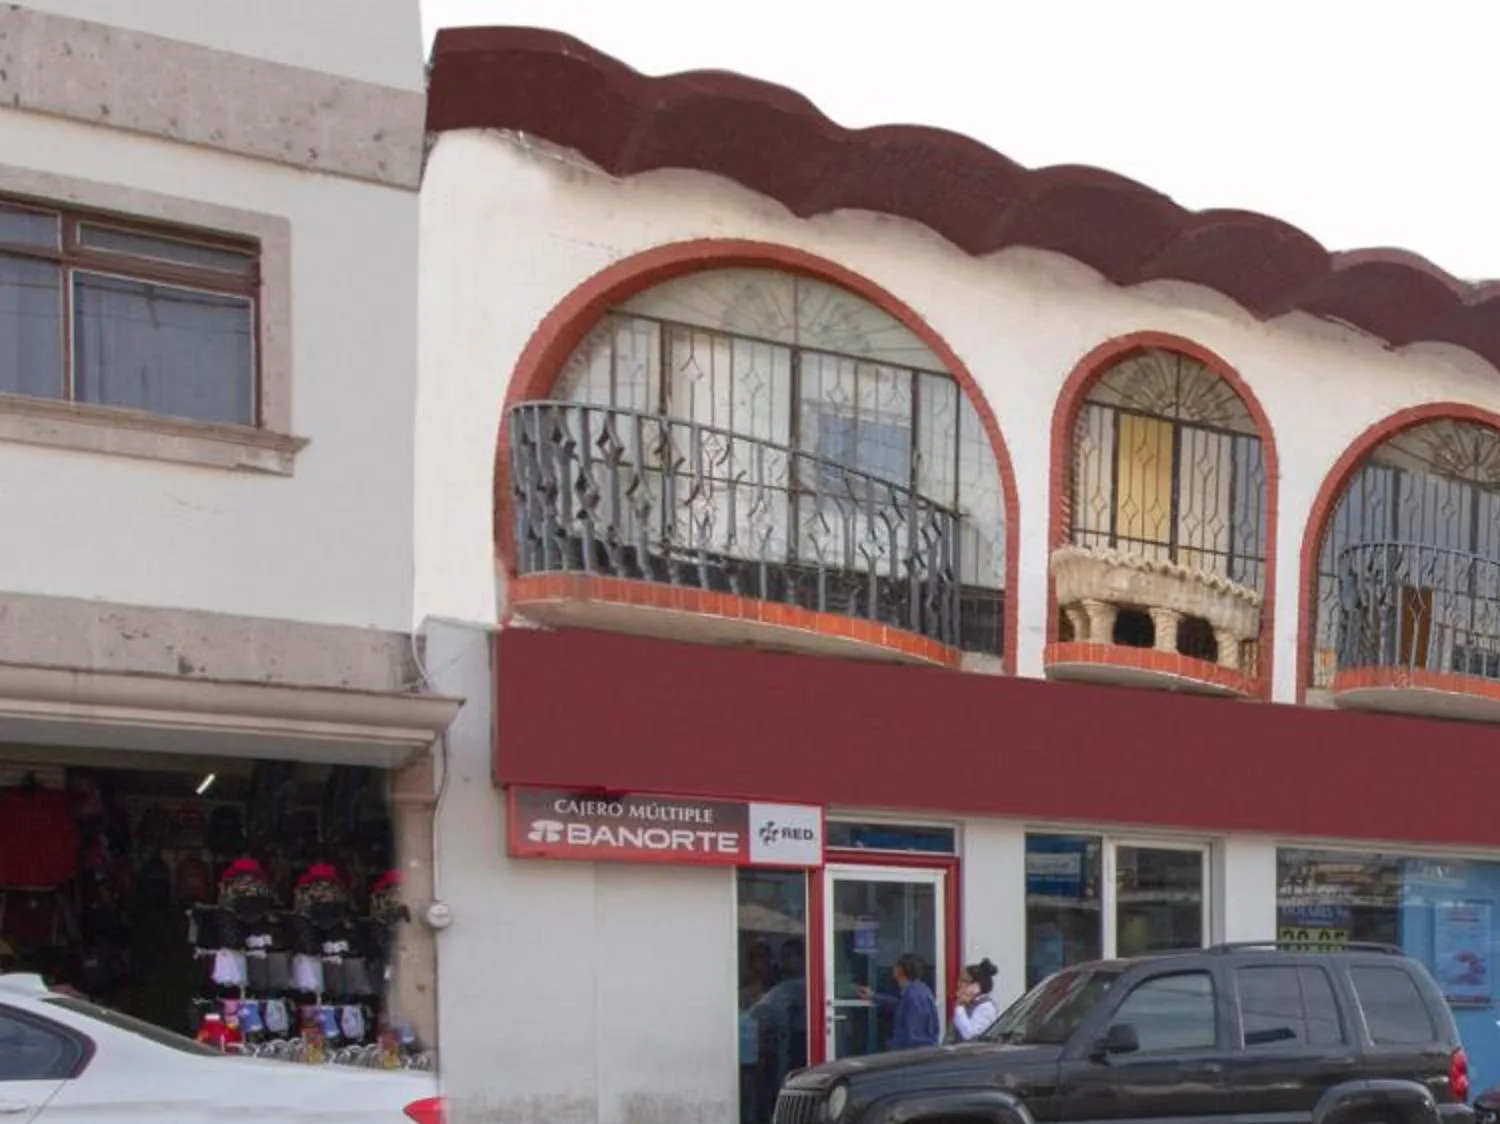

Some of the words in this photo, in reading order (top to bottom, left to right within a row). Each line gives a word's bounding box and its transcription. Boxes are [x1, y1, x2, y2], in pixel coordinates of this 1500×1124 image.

[554, 799, 623, 817] CAJERO
[629, 801, 714, 824] MÚLTIPLE
[567, 824, 738, 853] BANORTE
[781, 829, 815, 841] RED
